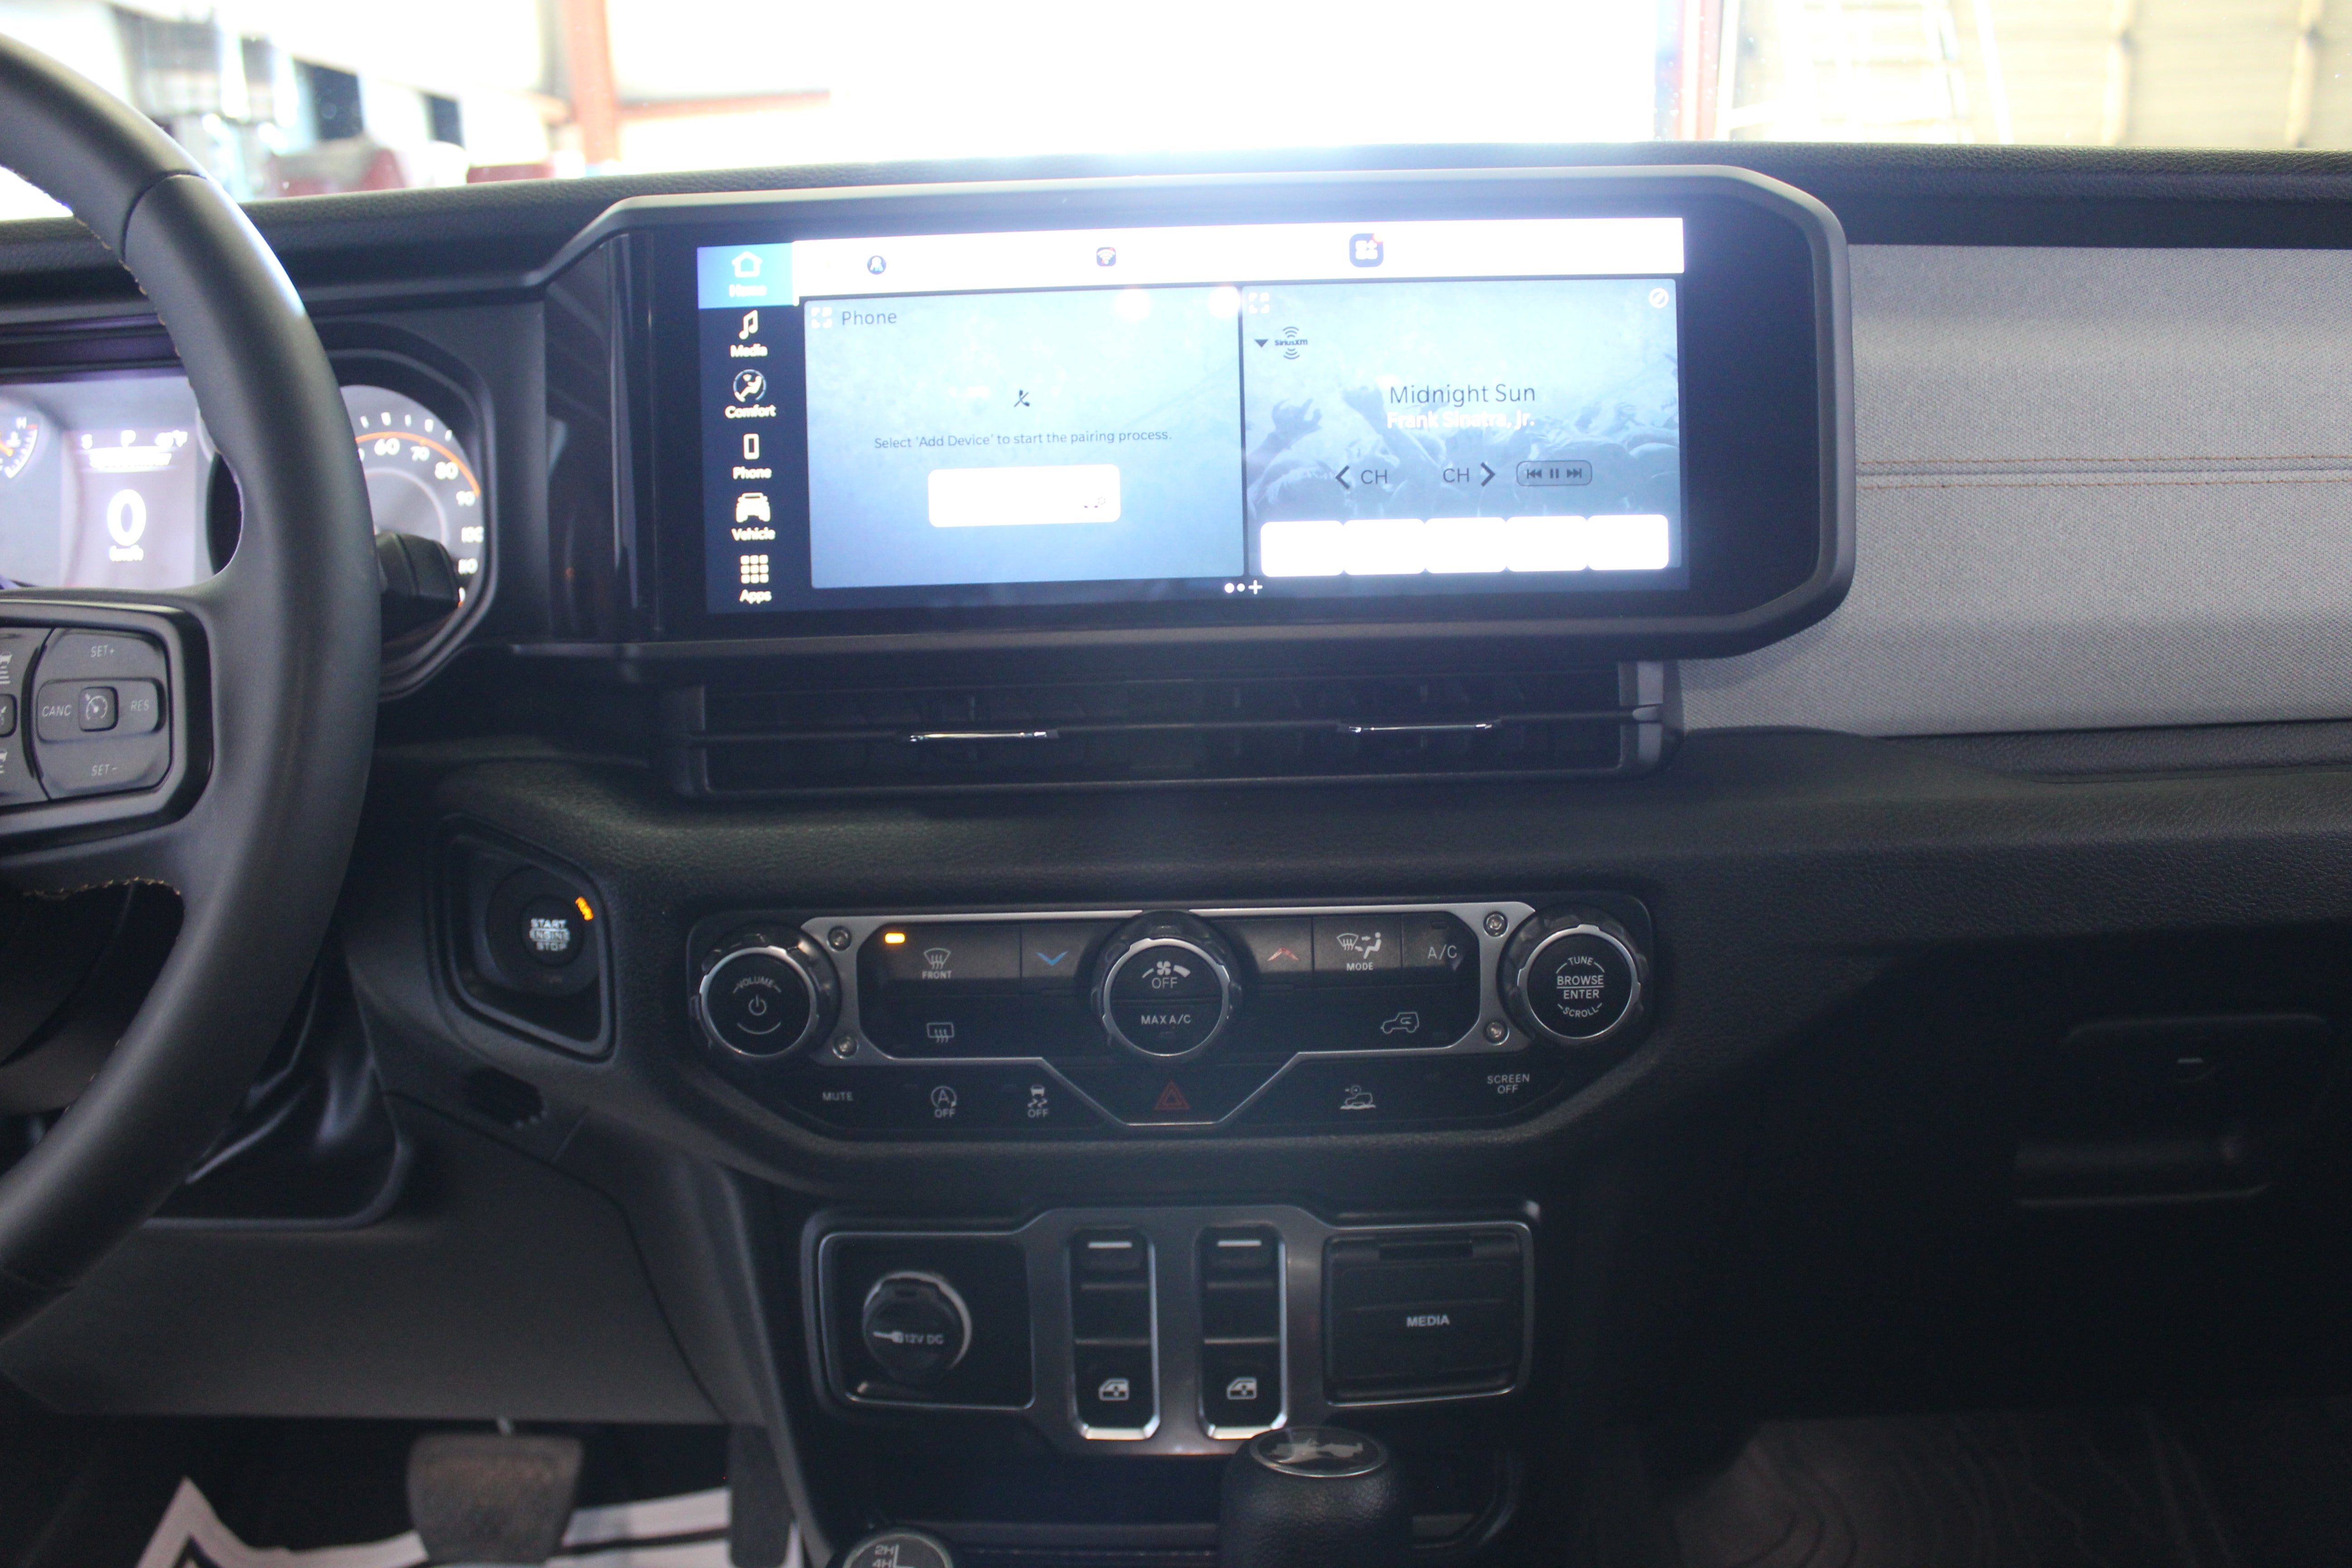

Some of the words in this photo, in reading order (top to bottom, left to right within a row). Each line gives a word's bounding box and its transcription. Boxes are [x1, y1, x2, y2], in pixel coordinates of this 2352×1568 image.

[729, 284, 767, 298] Home
[841, 310, 897, 326] Phone
[730, 344, 768, 358] Media
[1390, 385, 1490, 407] Midnight
[1495, 383, 1535, 402] Sun
[725, 404, 776, 419] Comfort
[1387, 412, 1439, 429] Frank
[1442, 411, 1513, 430] Sinatra,
[1515, 410, 1535, 430] Jr.
[874, 437, 912, 449] Select
[916, 436, 944, 447] 'Add
[947, 433, 994, 446] Device'
[997, 435, 1010, 445] to
[1013, 432, 1043, 444] start
[1047, 432, 1067, 443] the
[1071, 431, 1115, 445] pairing
[1118, 431, 1172, 444] process.
[374, 438, 400, 456] 60
[410, 446, 430, 461] 70
[434, 461, 459, 480] 80
[733, 466, 772, 480] Phone
[1443, 468, 1470, 483] CH
[1361, 470, 1388, 485] CH
[456, 490, 476, 507] 90
[107, 489, 147, 546] 0
[731, 527, 776, 541] Vehicle
[458, 558, 478, 574] 110
[739, 589, 772, 604] Apps
[42, 704, 71, 717] CANC
[130, 700, 149, 711] RES
[530, 918, 567, 928] START
[529, 929, 570, 941] ENGINE
[536, 941, 568, 951] STOP
[1428, 945, 1457, 960] A/C
[1346, 962, 1374, 971] MODE
[1568, 956, 1594, 967] TUNE
[922, 970, 952, 980] FRONT
[1557, 975, 1604, 986] BROWSE
[736, 976, 775, 989] VOLUME
[1152, 978, 1178, 989] OFF
[1563, 989, 1600, 1000] ENTER
[1563, 1006, 1599, 1018] SCROLL
[1141, 1014, 1167, 1025] MAX
[1169, 1014, 1191, 1024] A/C
[1487, 1074, 1530, 1084] SCREEN
[1497, 1084, 1519, 1094] OFF
[823, 1092, 853, 1101] MUTE
[935, 1109, 956, 1118] OFF
[1028, 1109, 1049, 1118] OFF
[1406, 1314, 1450, 1328] MEDIA
[926, 1334, 944, 1344] DC
[874, 1544, 895, 1556] 2H
